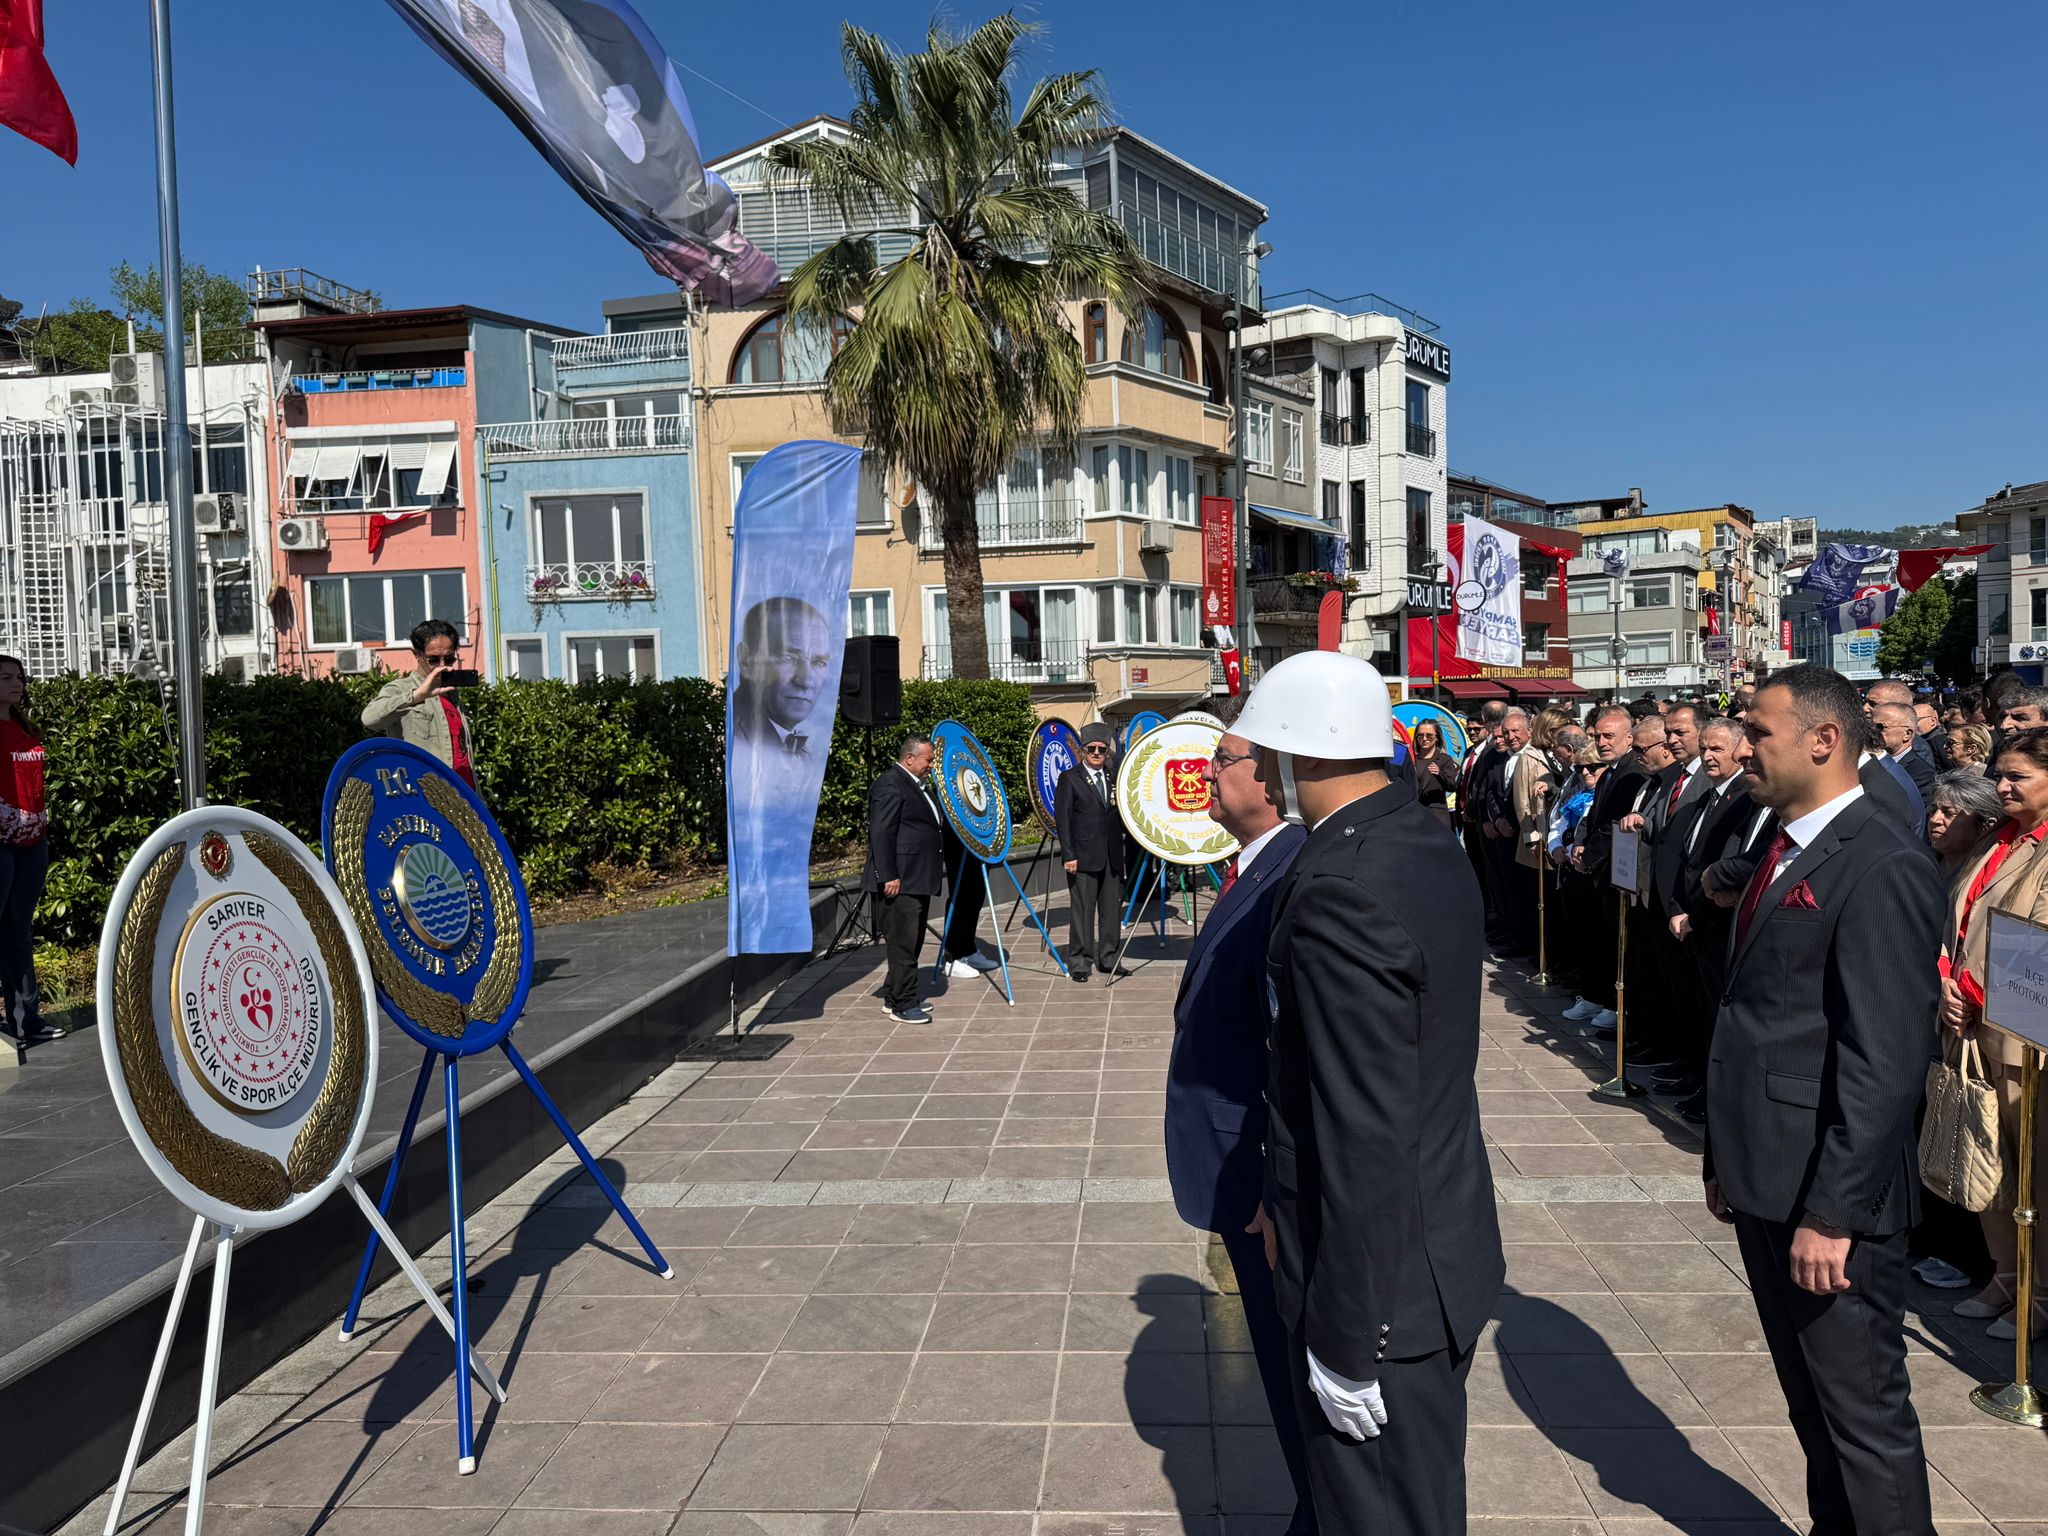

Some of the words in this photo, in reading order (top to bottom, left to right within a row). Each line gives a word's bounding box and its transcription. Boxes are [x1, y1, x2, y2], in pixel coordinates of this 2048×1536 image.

[1405, 333, 1449, 375] ÜRÜMLE
[1407, 582, 1452, 610] ÜRÜMLE
[377, 815, 442, 848] SARIYER
[207, 901, 266, 931] SARIYER
[237, 950, 266, 961] GENÇLİK
[266, 959, 275, 970] VE
[274, 968, 287, 993] SPOR
[2024, 965, 2045, 987] İLÇE
[2008, 979, 2048, 1008] PROTOKO
[185, 991, 222, 1078] GENÇLİK
[222, 1072, 238, 1095] VE
[240, 1086, 276, 1104] SPOR
[279, 1068, 303, 1099] İLÇE
[300, 957, 319, 1070] MÜDÜRLÜĞÜ
